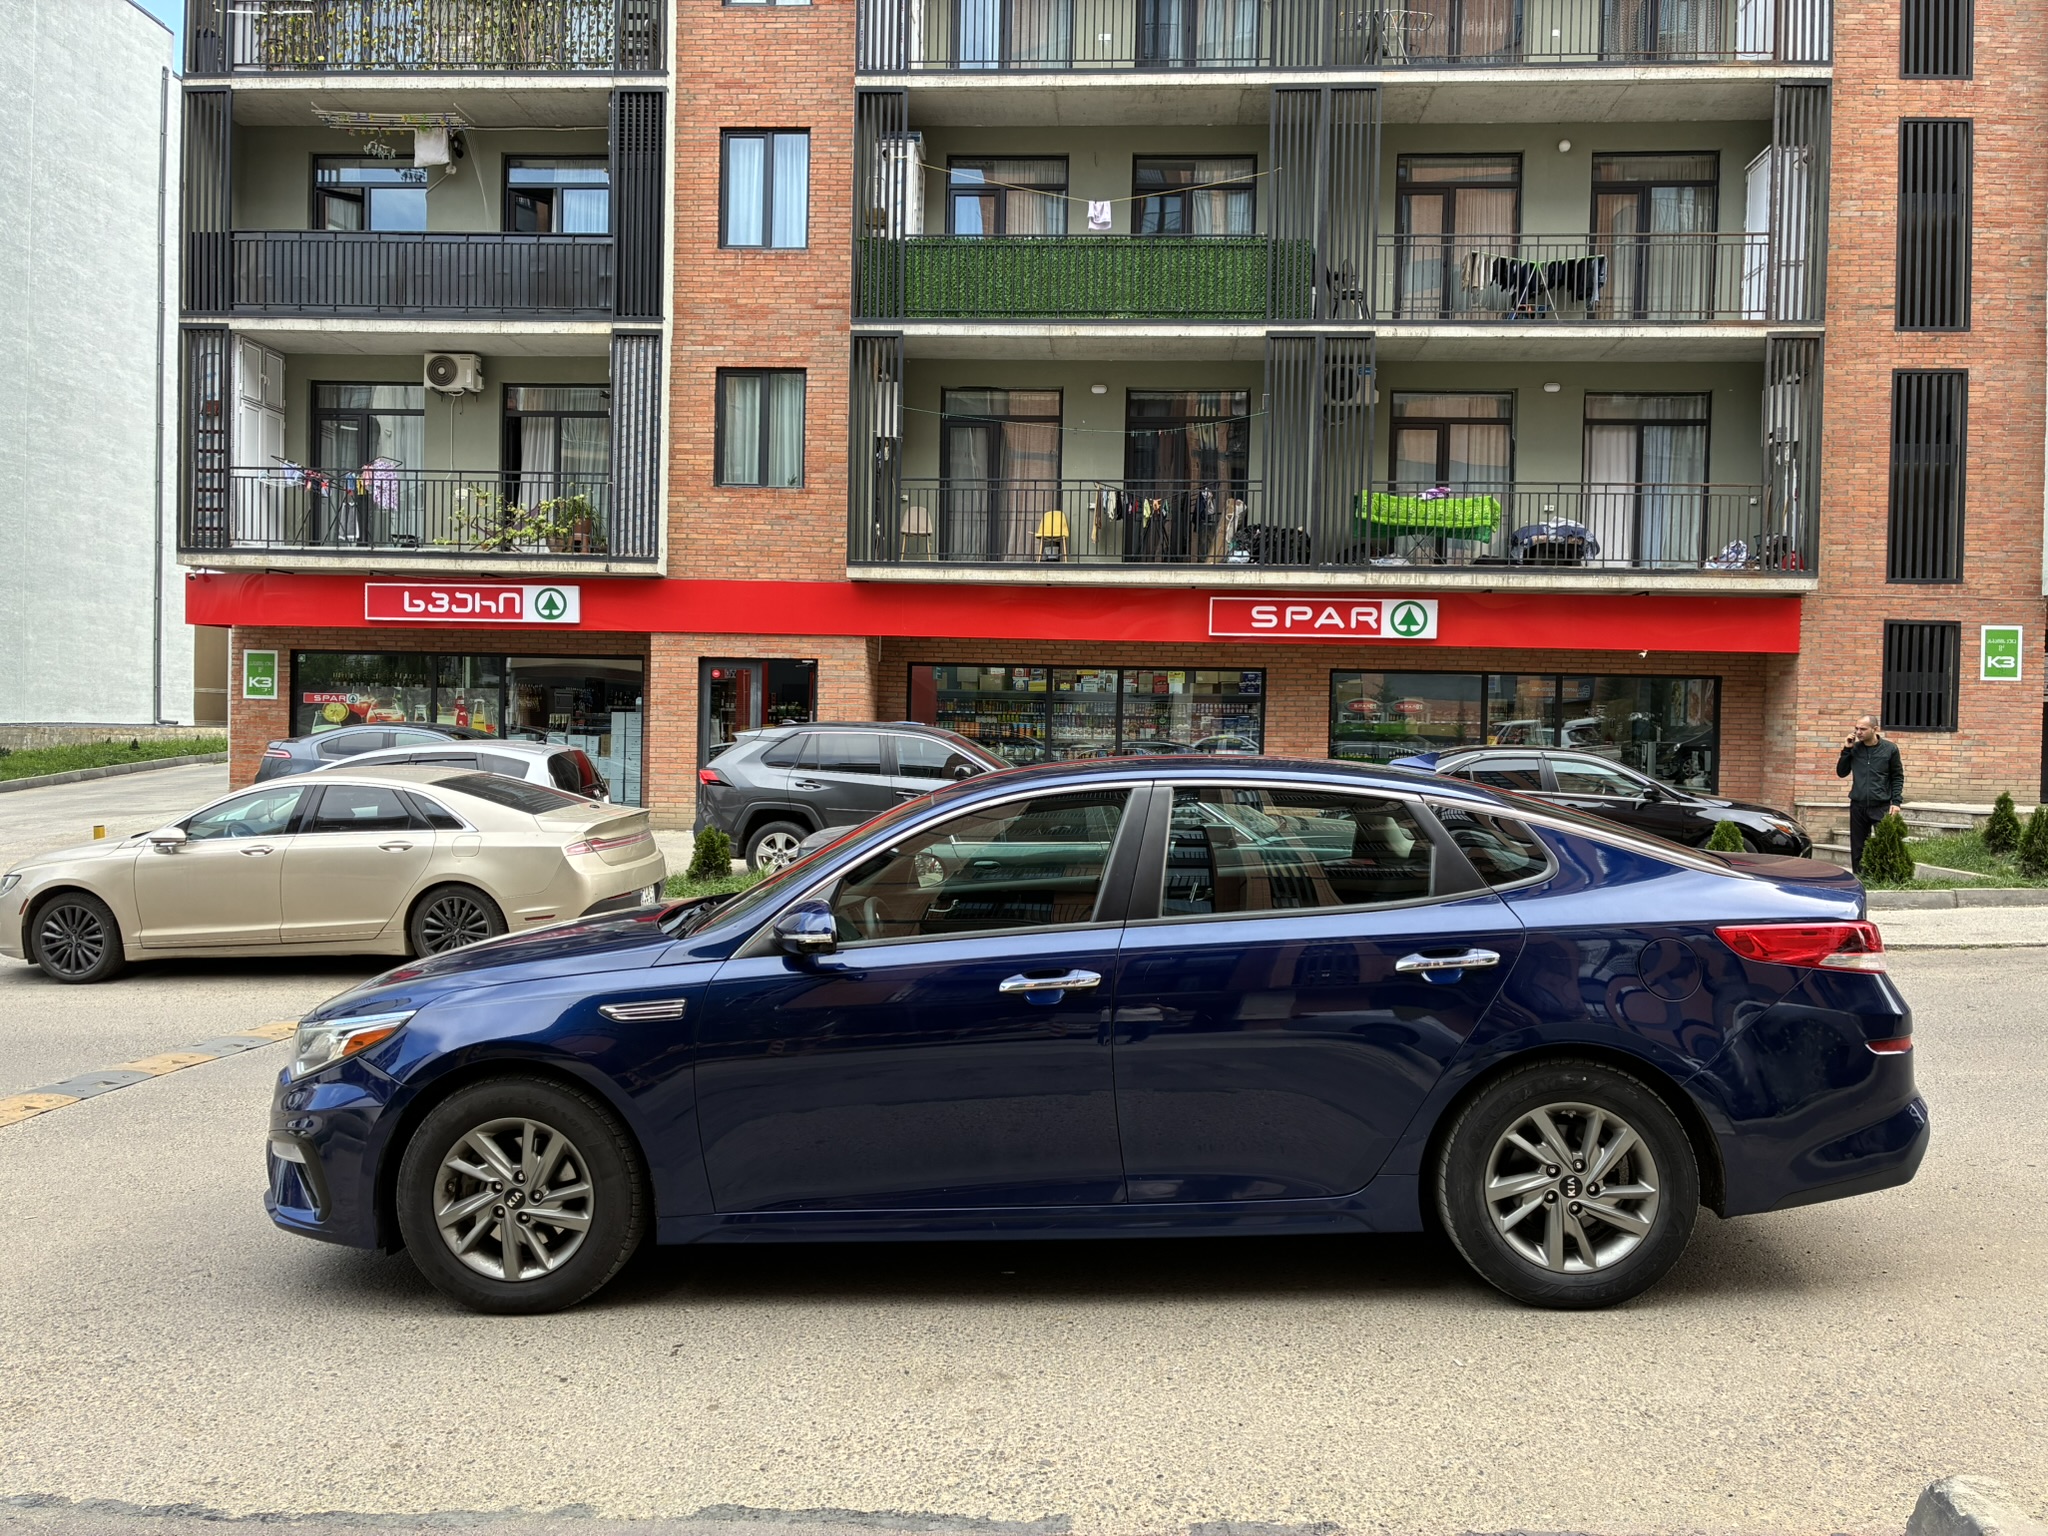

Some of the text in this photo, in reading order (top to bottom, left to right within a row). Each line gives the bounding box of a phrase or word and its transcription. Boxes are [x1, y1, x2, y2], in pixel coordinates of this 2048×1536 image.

[403, 591, 521, 614] სპარი
[1251, 605, 1378, 629] SPAR
[1987, 655, 2015, 668] K3
[248, 676, 272, 688] K3
[313, 694, 346, 702] SPAR
[1566, 1177, 1576, 1197] KIA
[506, 1191, 523, 1208] KIA
